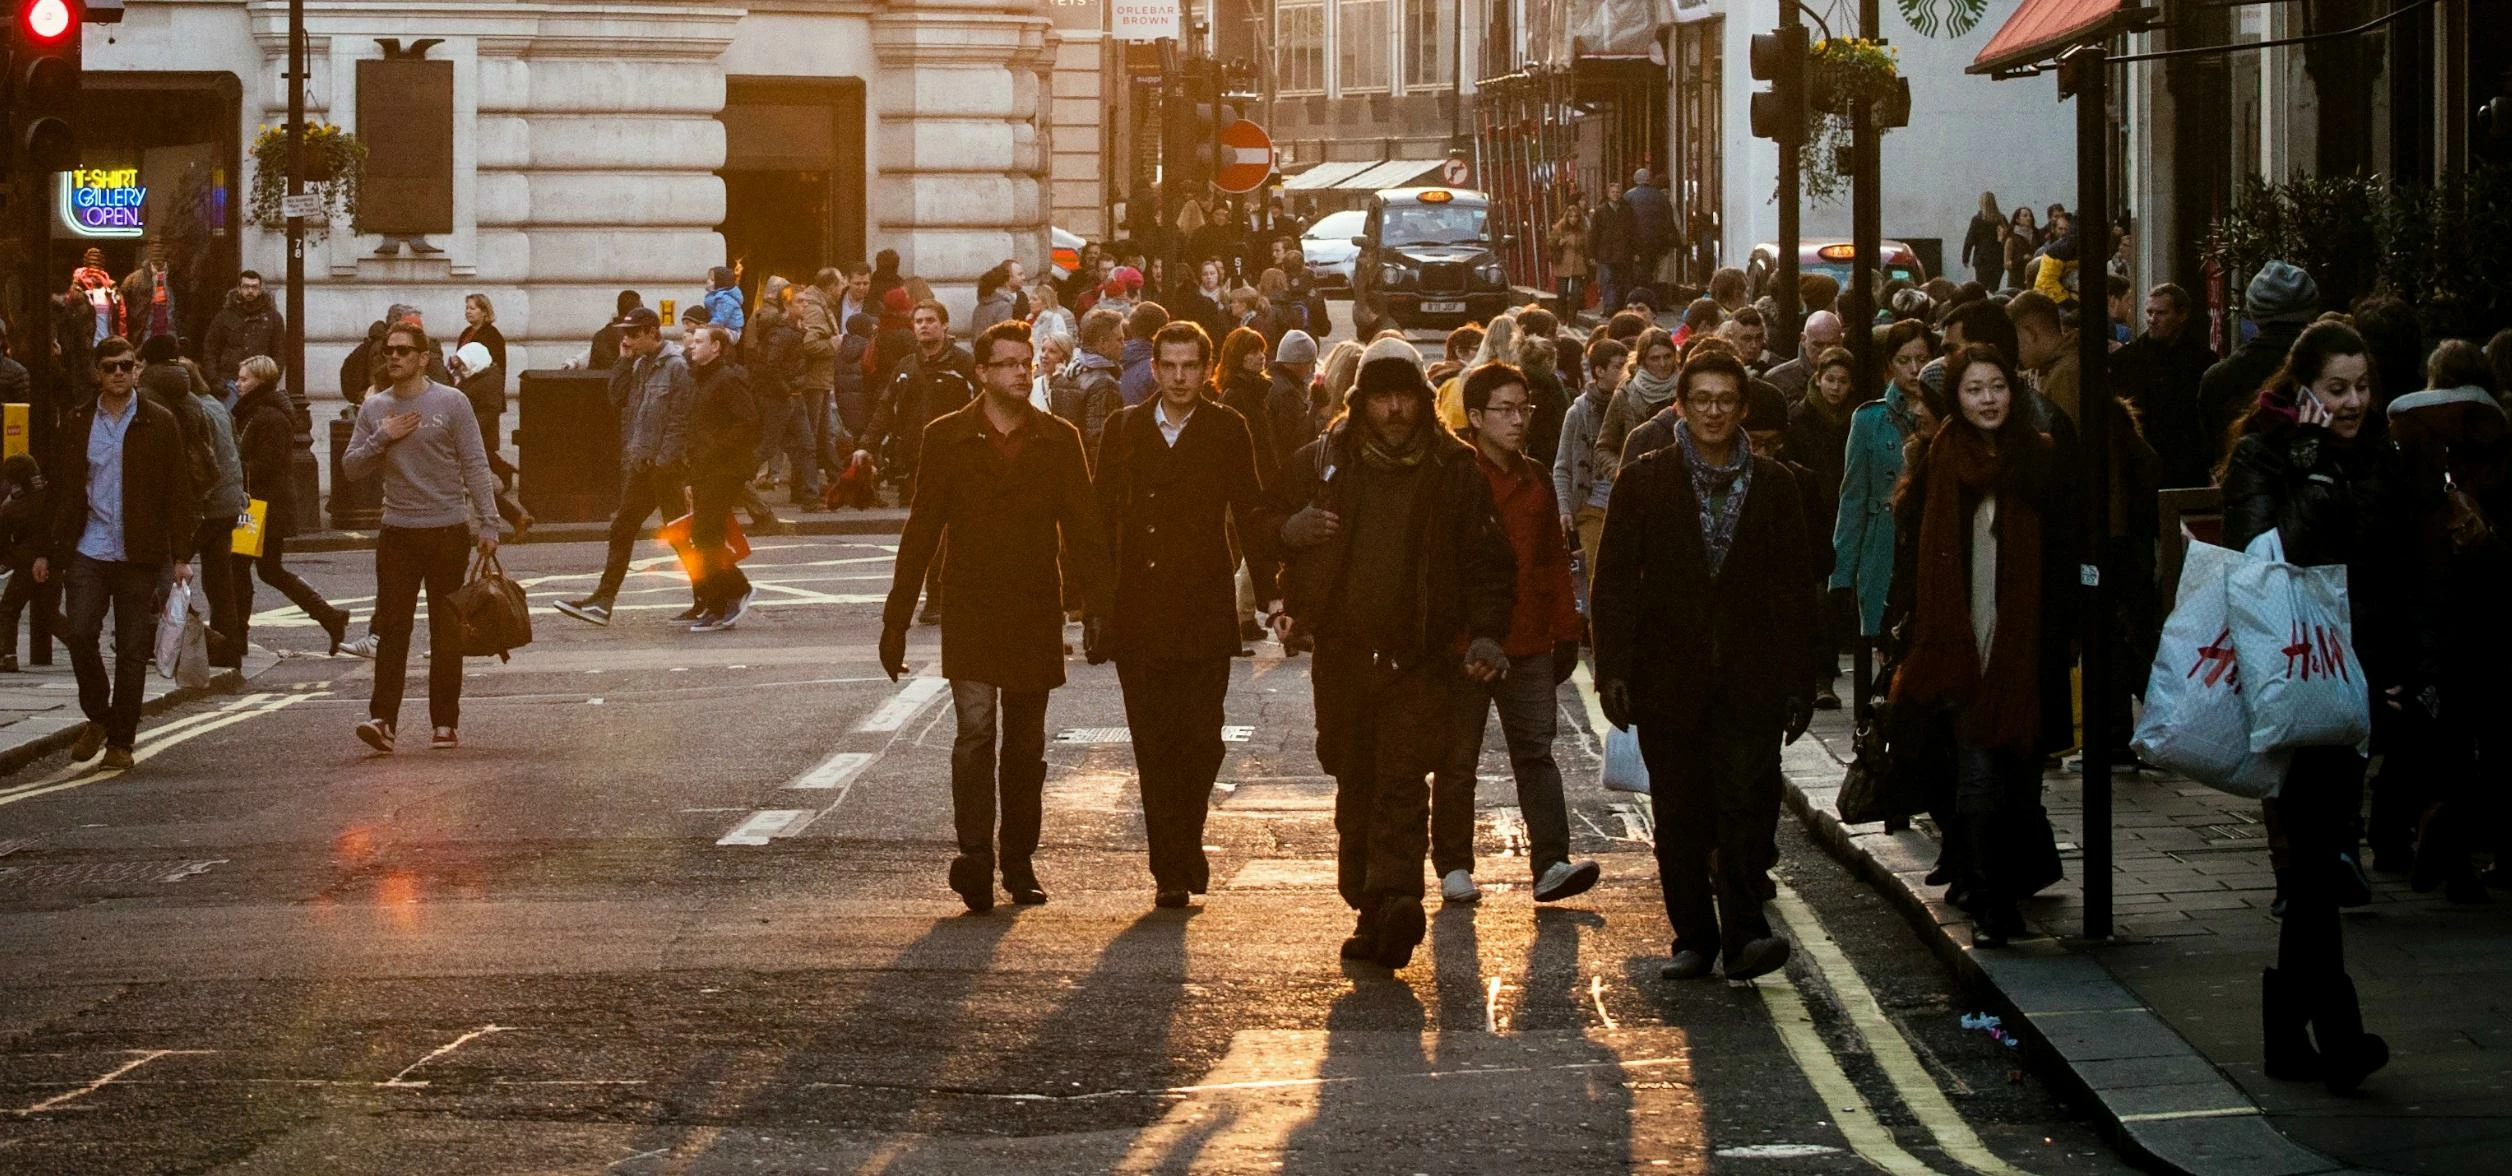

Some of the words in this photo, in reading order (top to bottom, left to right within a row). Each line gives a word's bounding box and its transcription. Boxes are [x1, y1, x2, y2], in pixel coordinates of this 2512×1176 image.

[1117, 6, 1174, 15] ORLEBAR
[1122, 16, 1169, 25] BROWN
[73, 169, 138, 189] T-SHIRT
[78, 187, 146, 206] GALLERY
[2186, 626, 2242, 696] H&
[2280, 618, 2350, 686] H&M
